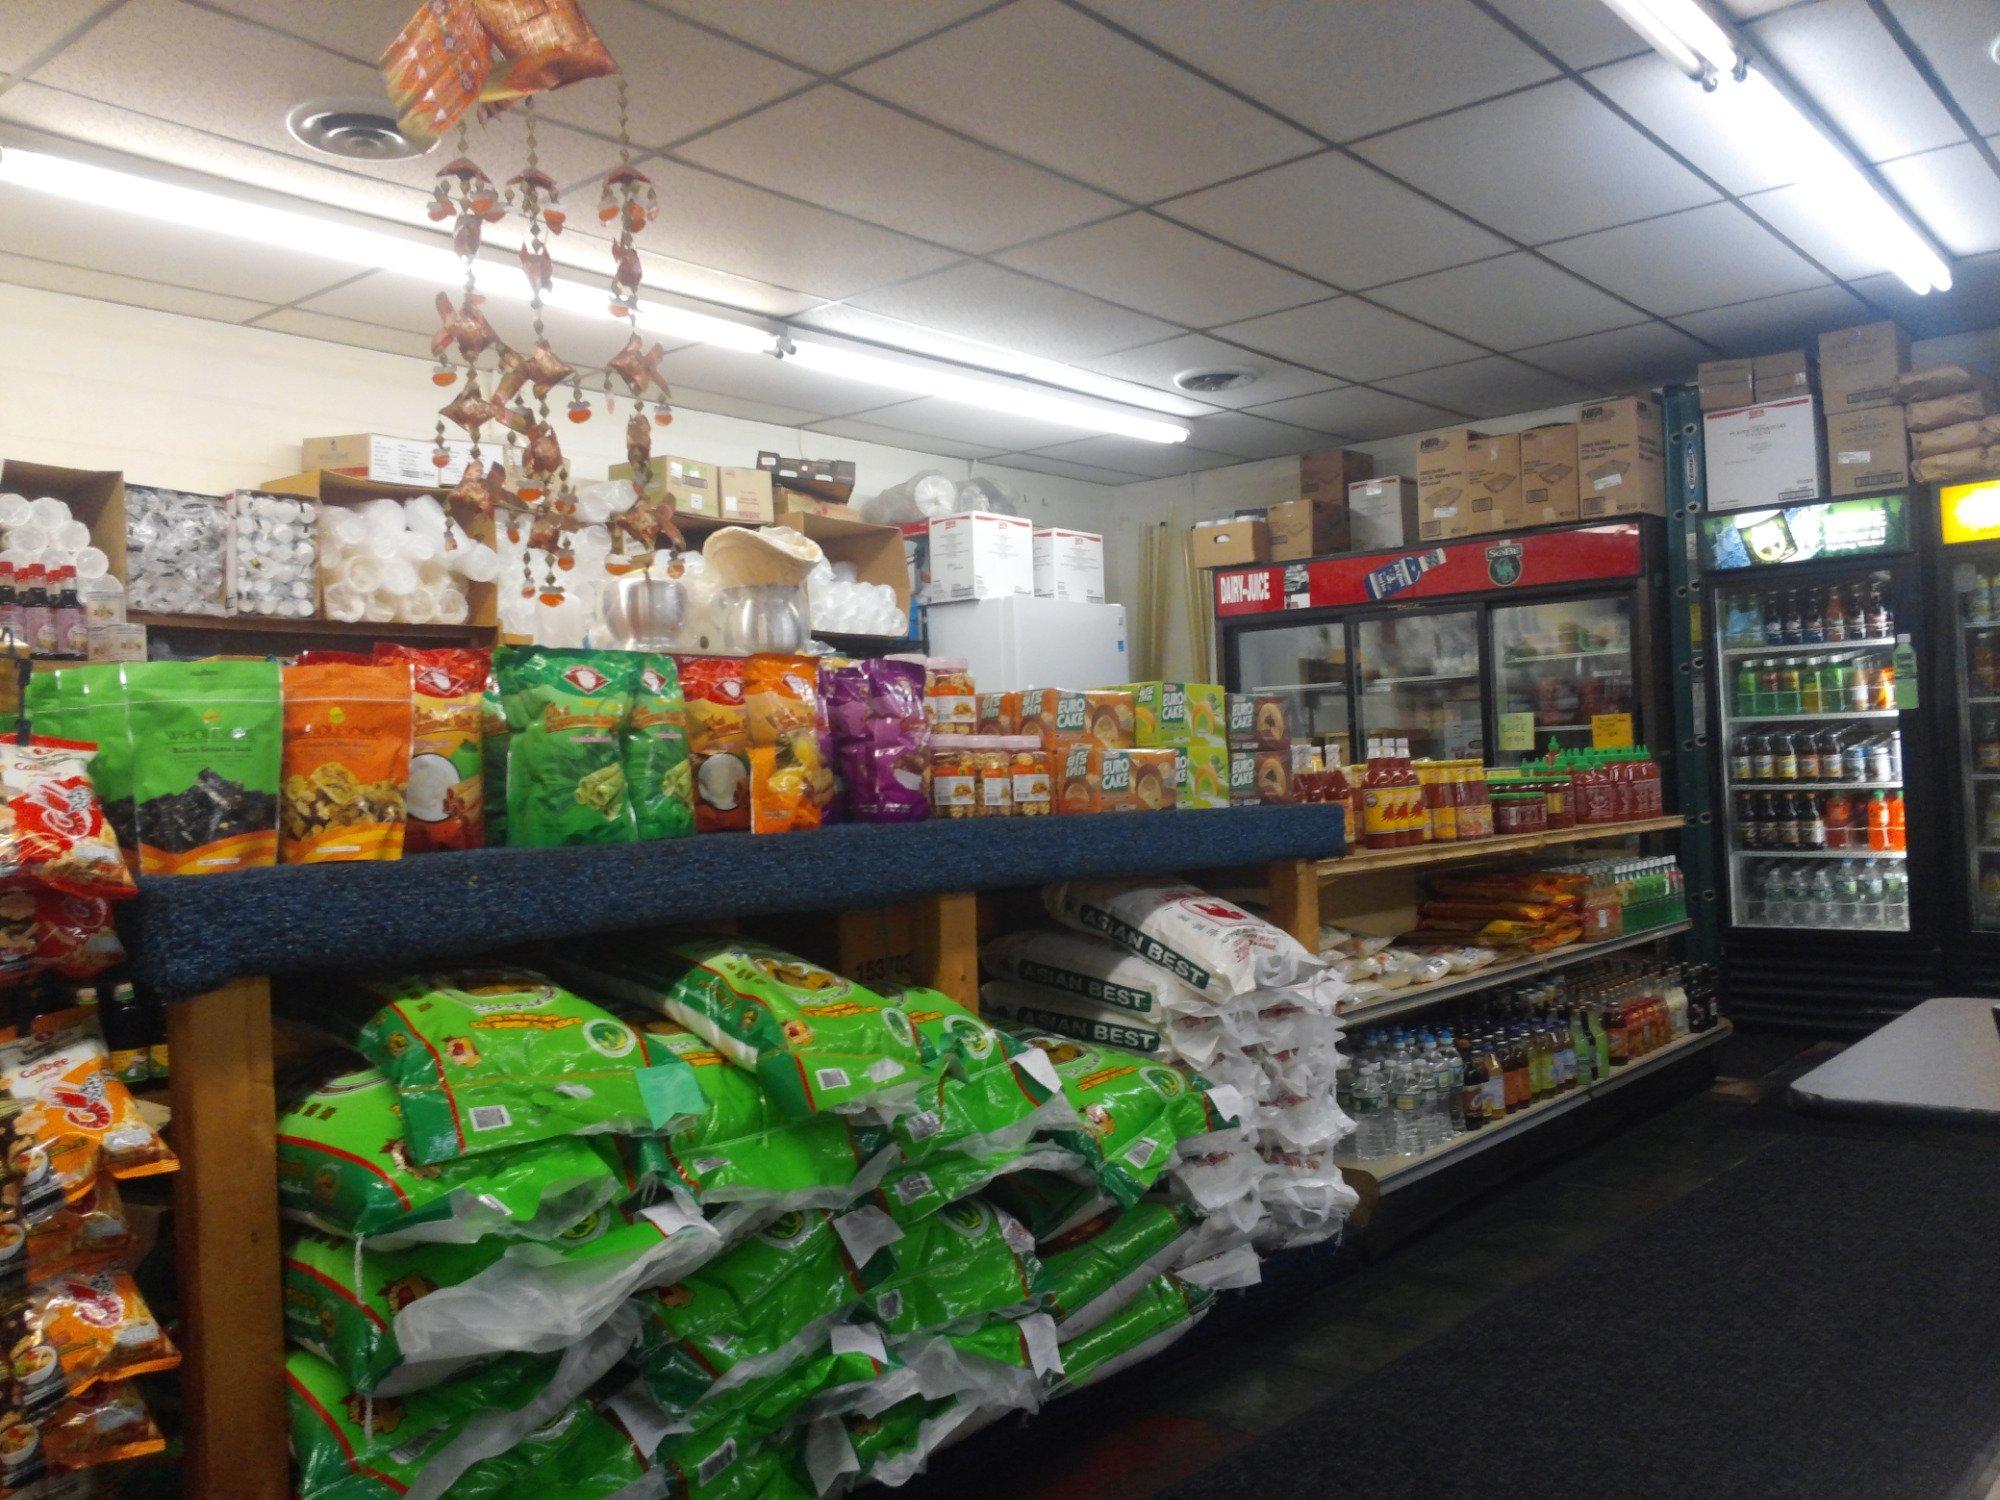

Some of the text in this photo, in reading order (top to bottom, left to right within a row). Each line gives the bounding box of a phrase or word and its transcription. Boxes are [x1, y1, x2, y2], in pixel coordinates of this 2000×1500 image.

[1058, 698, 1086, 714] EURO
[1162, 705, 1185, 720] CAKE
[1057, 712, 1085, 729] CAKE
[1231, 714, 1254, 729] CAKE
[1103, 758, 1130, 775] EURO
[1101, 772, 1130, 789] CAKE
[1231, 771, 1254, 787] CAKE
[1082, 909, 1144, 950] ASIAN
[1147, 941, 1207, 987] BEST
[1024, 964, 1146, 1008] ASIAN BEST
[1094, 1024, 1156, 1049] BEST
[20, 1057, 70, 1078] Calbee
